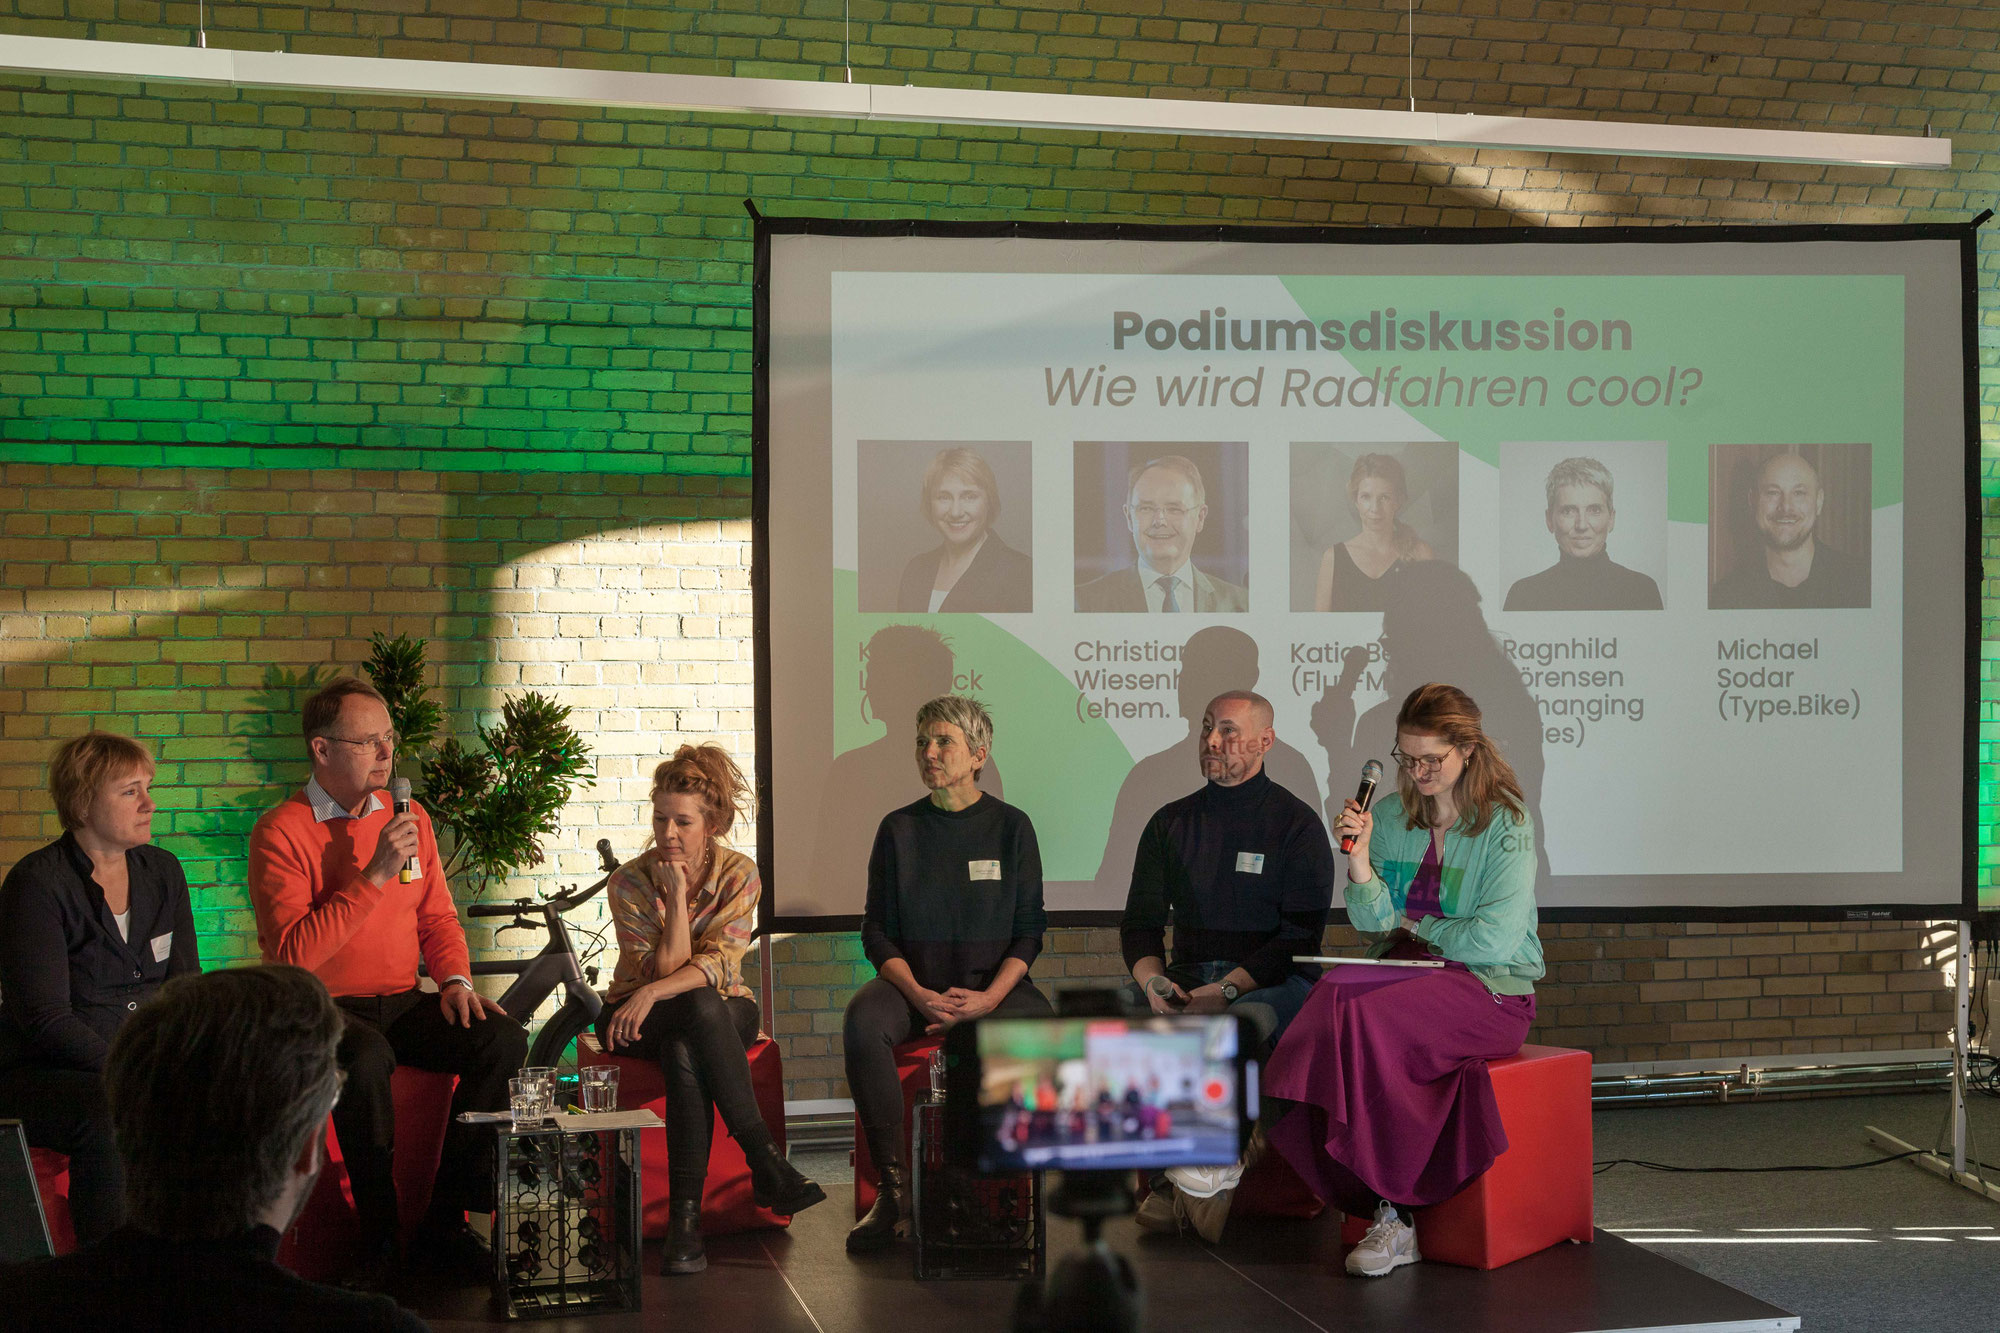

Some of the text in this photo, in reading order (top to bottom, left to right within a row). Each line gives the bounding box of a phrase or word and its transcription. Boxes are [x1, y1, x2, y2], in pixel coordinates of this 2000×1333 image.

[1113, 306, 1632, 351] Podiumsdiskussion
[1044, 364, 1704, 407] Wie wird Radfahren cool?
[1503, 637, 1617, 667] Ragnhild
[1717, 638, 1818, 660] Michael
[1520, 666, 1624, 688] örensen
[1717, 667, 1795, 688] Sodar
[1076, 692, 1171, 723] (ehem.
[1535, 693, 1645, 722] hanging
[1718, 688, 1861, 723] (Type.Bike)
